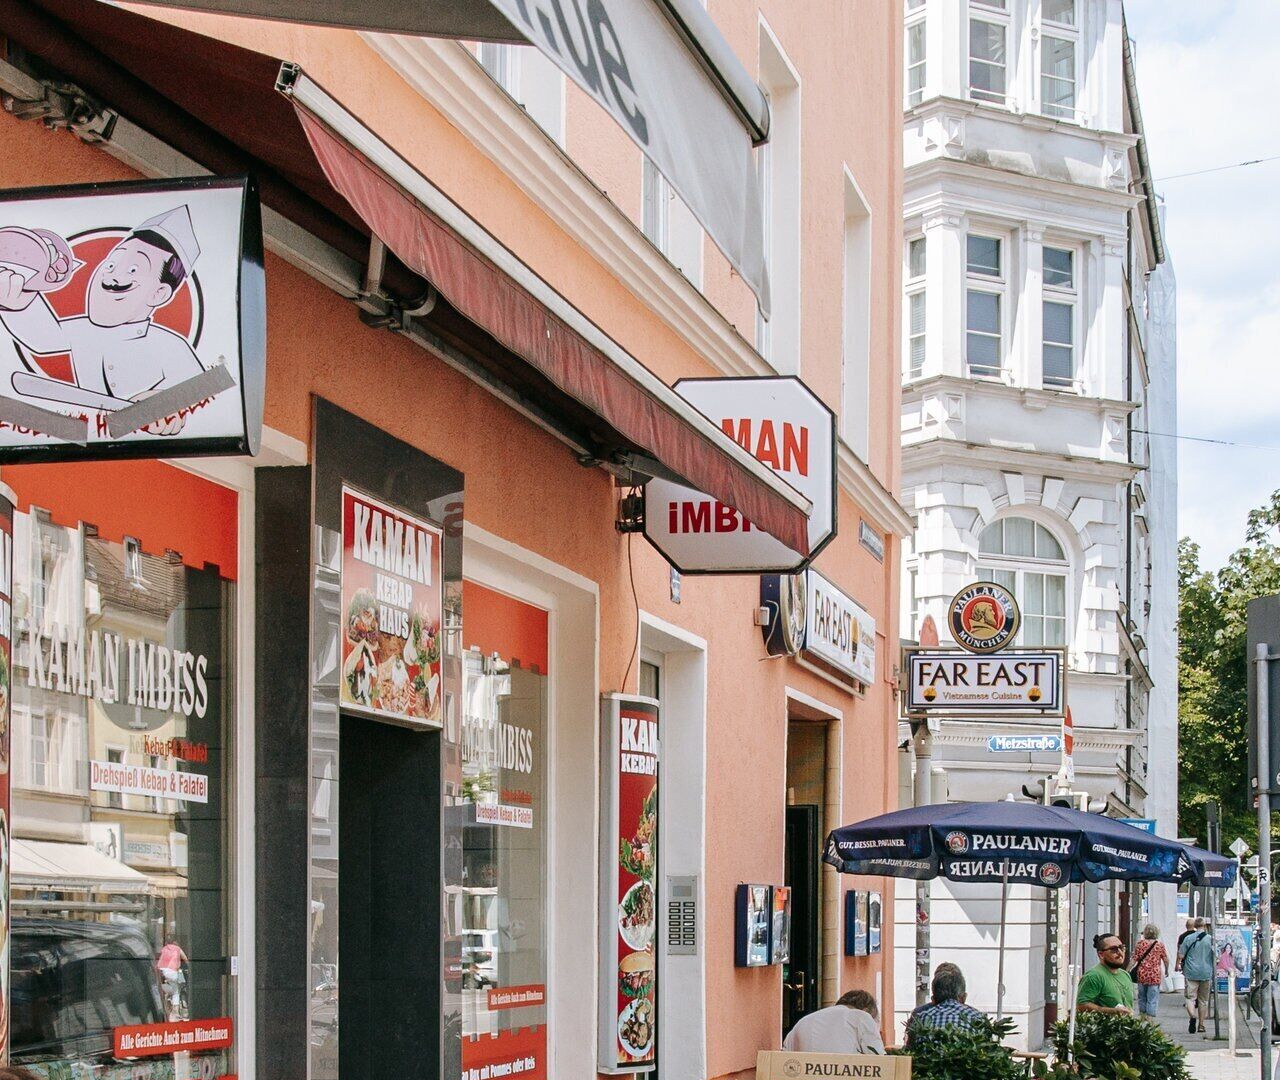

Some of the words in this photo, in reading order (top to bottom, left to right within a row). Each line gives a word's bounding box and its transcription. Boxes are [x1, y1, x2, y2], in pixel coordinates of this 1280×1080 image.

[353, 501, 432, 587] KAMAN
[376, 573, 413, 610] KEBAP
[953, 586, 1014, 614] PAULANER
[379, 604, 410, 640] HAUS
[28, 615, 120, 704] KAMAN
[127, 638, 208, 719] IMBISS
[918, 662, 970, 687] FAR
[976, 662, 1046, 687] EAST
[942, 691, 990, 700] Vietnamese
[991, 691, 1023, 700] Cuisine
[995, 735, 1056, 750] Metzstraße
[93, 763, 139, 788] Drehspieß
[141, 771, 168, 793] Kebap
[170, 776, 176, 793] &
[179, 774, 207, 797] Falafel
[972, 834, 1071, 854] PAULANER
[120, 1034, 134, 1050] Alle
[135, 1033, 163, 1049] Gerichte
[163, 1030, 180, 1045] Auch
[180, 1031, 194, 1044] zum
[194, 1026, 228, 1042] Mitnehmen
[805, 1062, 881, 1078] PAULANER
